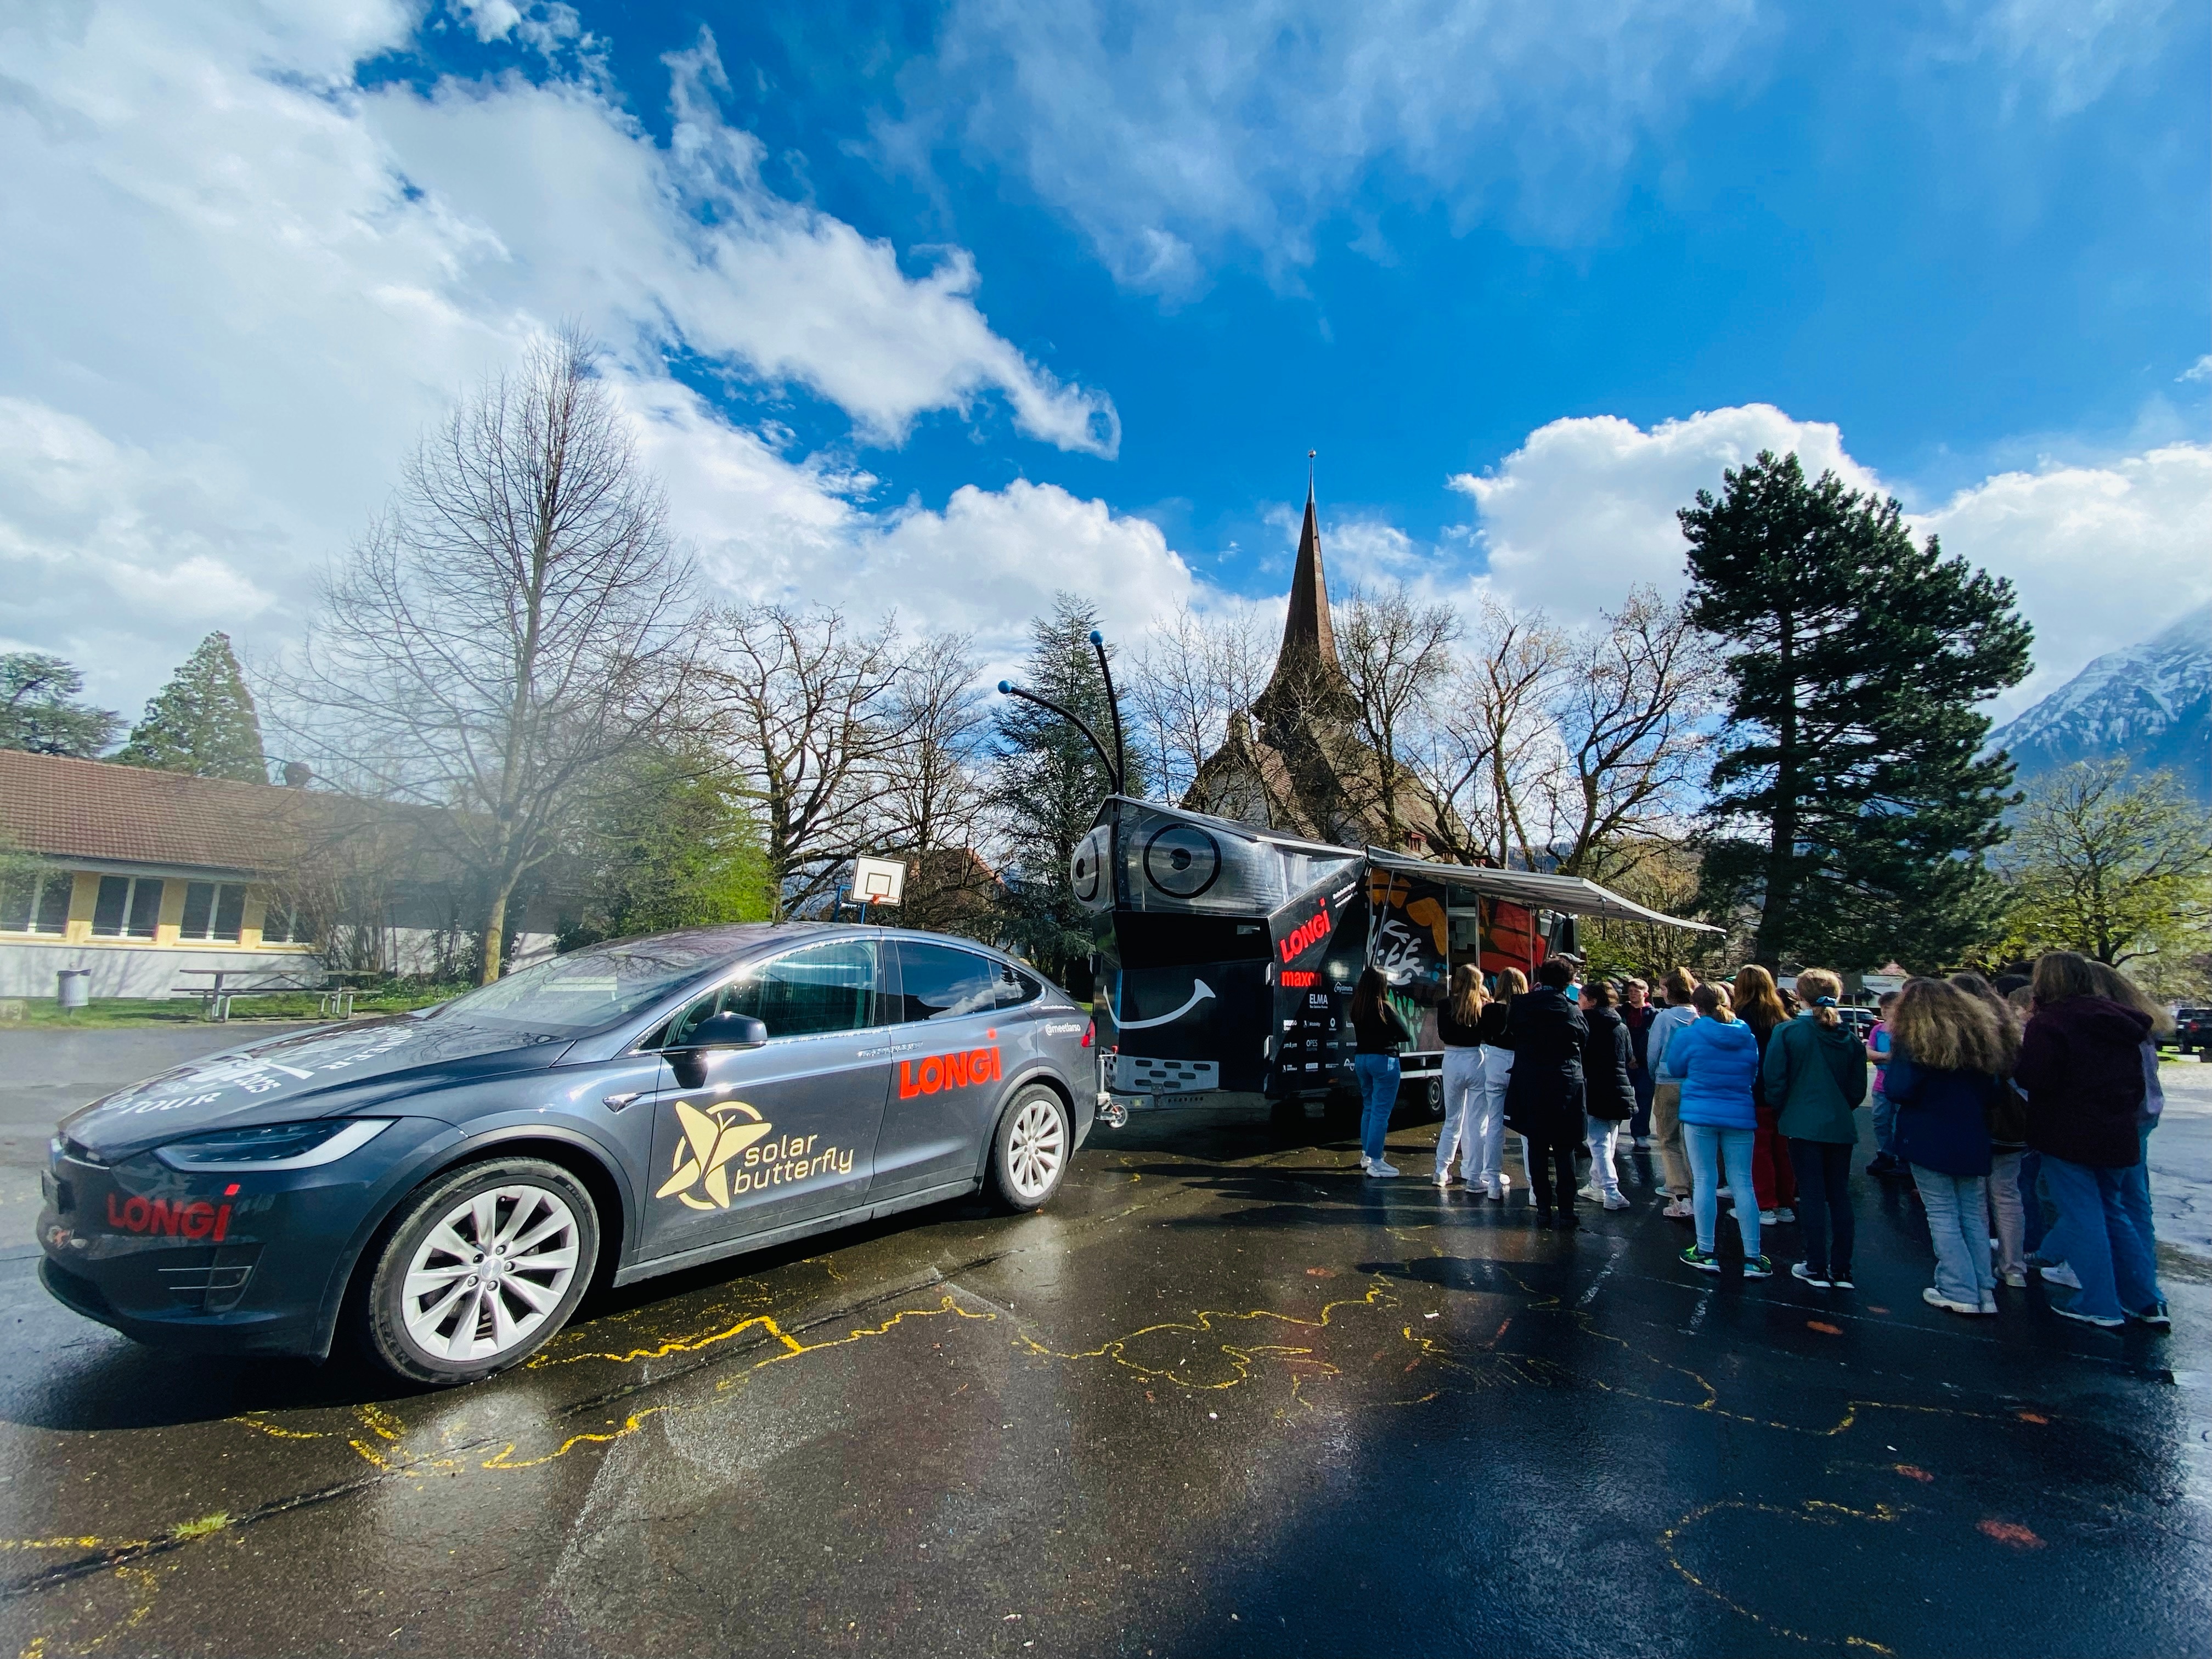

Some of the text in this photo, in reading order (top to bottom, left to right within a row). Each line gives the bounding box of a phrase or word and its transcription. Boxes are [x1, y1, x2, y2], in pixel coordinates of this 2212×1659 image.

[1282, 972, 1322, 987] maxon
[1309, 994, 1328, 1005] ELMA
[1045, 1023, 1081, 1036] @meetlarso
[233, 1073, 283, 1094] 2025
[744, 1133, 819, 1167] solar
[733, 1147, 855, 1195] butterfly
